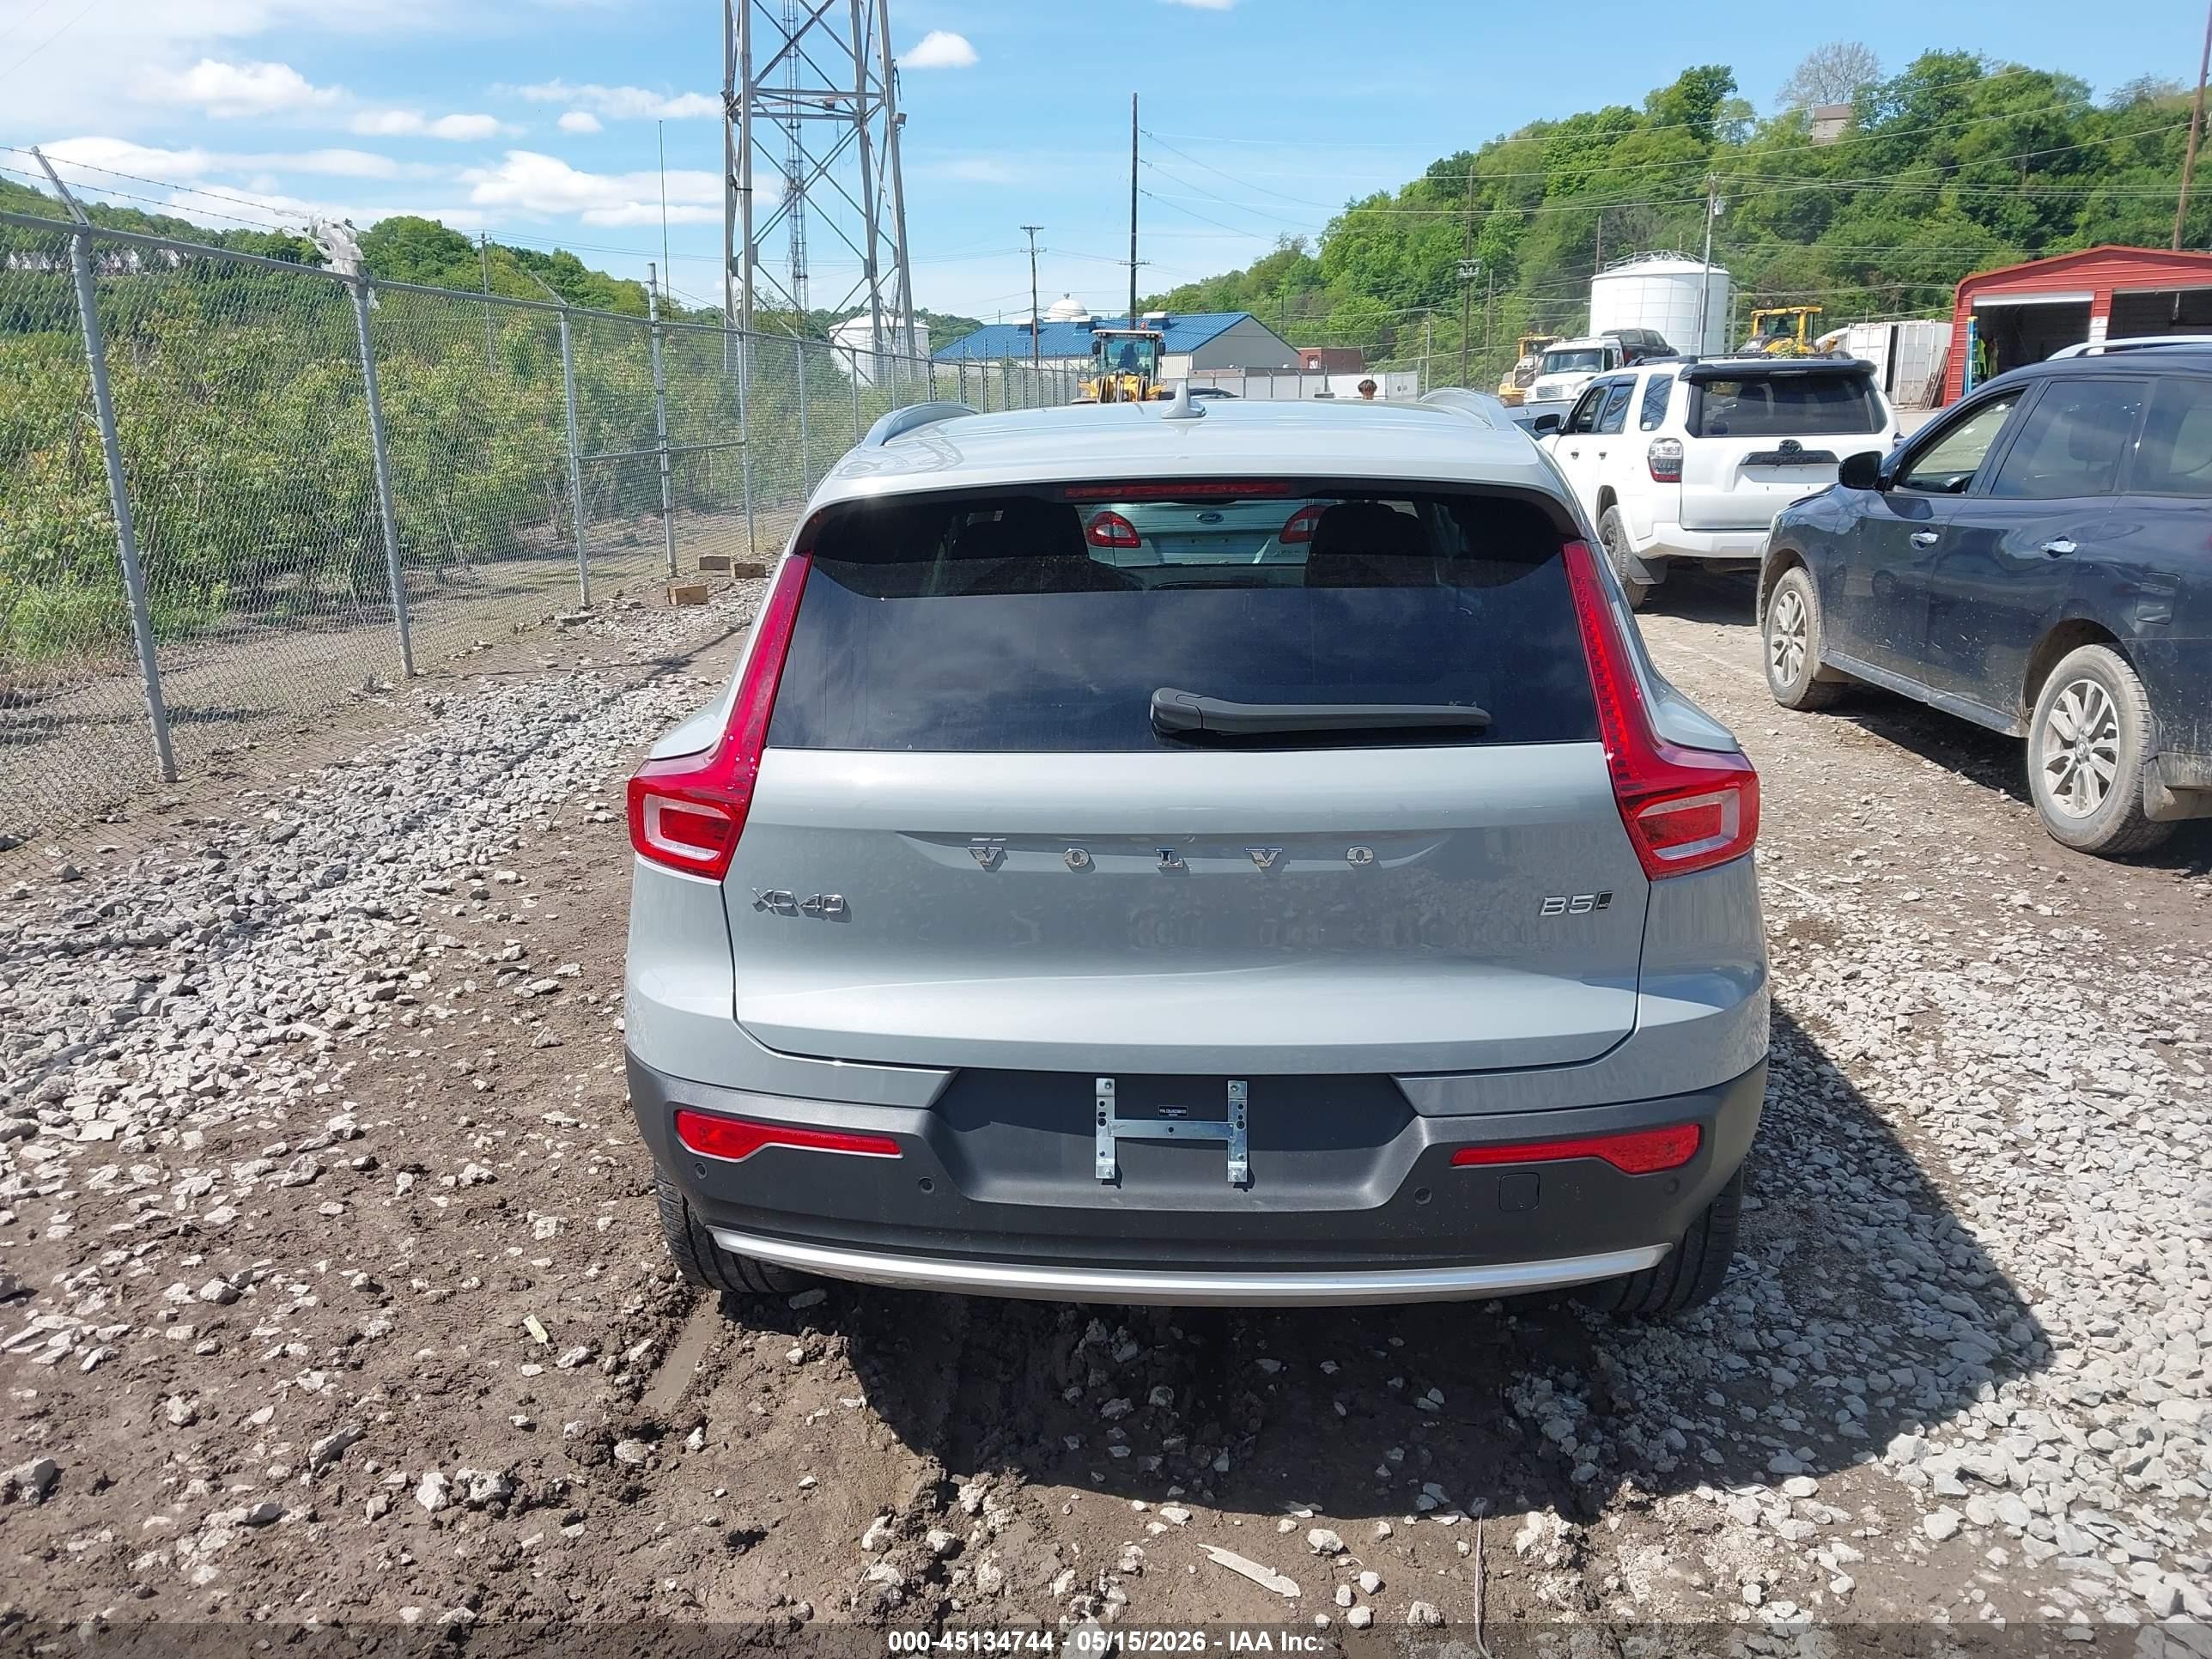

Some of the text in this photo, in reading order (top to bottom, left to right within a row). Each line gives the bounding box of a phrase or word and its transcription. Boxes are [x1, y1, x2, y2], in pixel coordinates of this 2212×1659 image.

[968, 845, 1376, 869] VOLVO
[751, 887, 844, 914] XC40
[1539, 894, 1595, 916] B5
